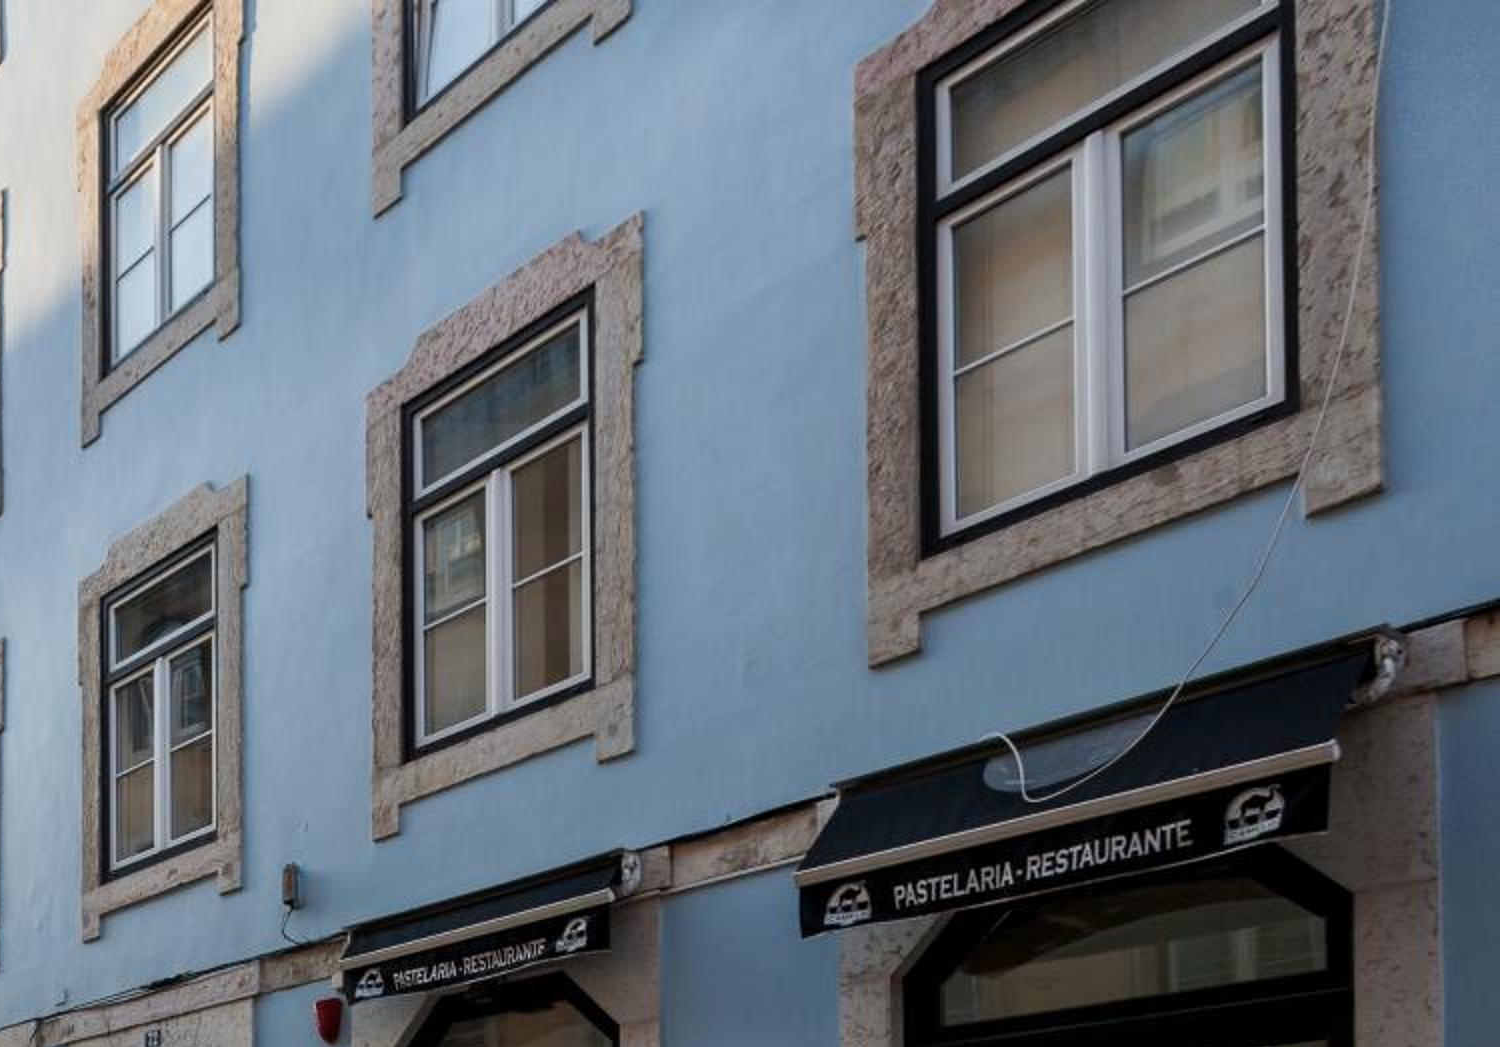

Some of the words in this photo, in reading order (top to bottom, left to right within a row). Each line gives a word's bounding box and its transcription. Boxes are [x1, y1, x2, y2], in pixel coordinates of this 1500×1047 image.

[893, 861, 1014, 910] PASTELARIA
[1026, 818, 1194, 881] RESTAURANTE
[393, 960, 457, 991] PASTELARIA
